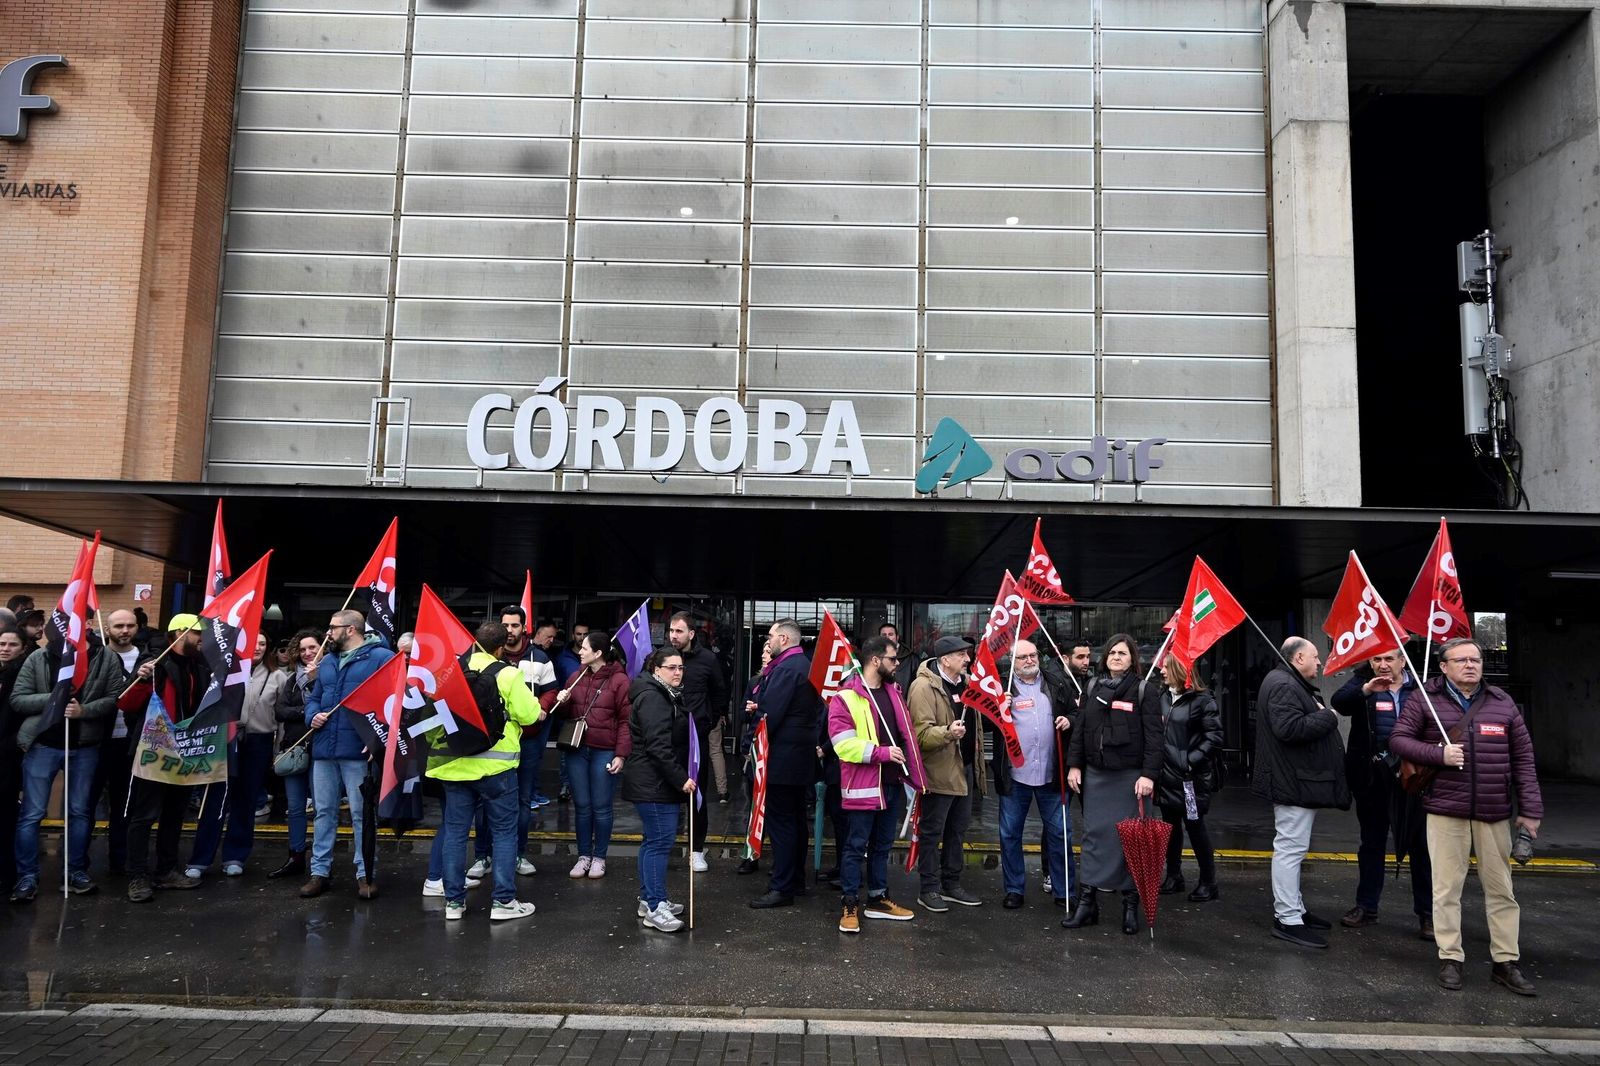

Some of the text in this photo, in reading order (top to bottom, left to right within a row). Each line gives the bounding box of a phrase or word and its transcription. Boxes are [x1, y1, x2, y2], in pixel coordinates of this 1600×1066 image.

[466, 376, 871, 476] CÓRDOBA
[1004, 435, 1168, 483] adif
[402, 637, 460, 739] GT
